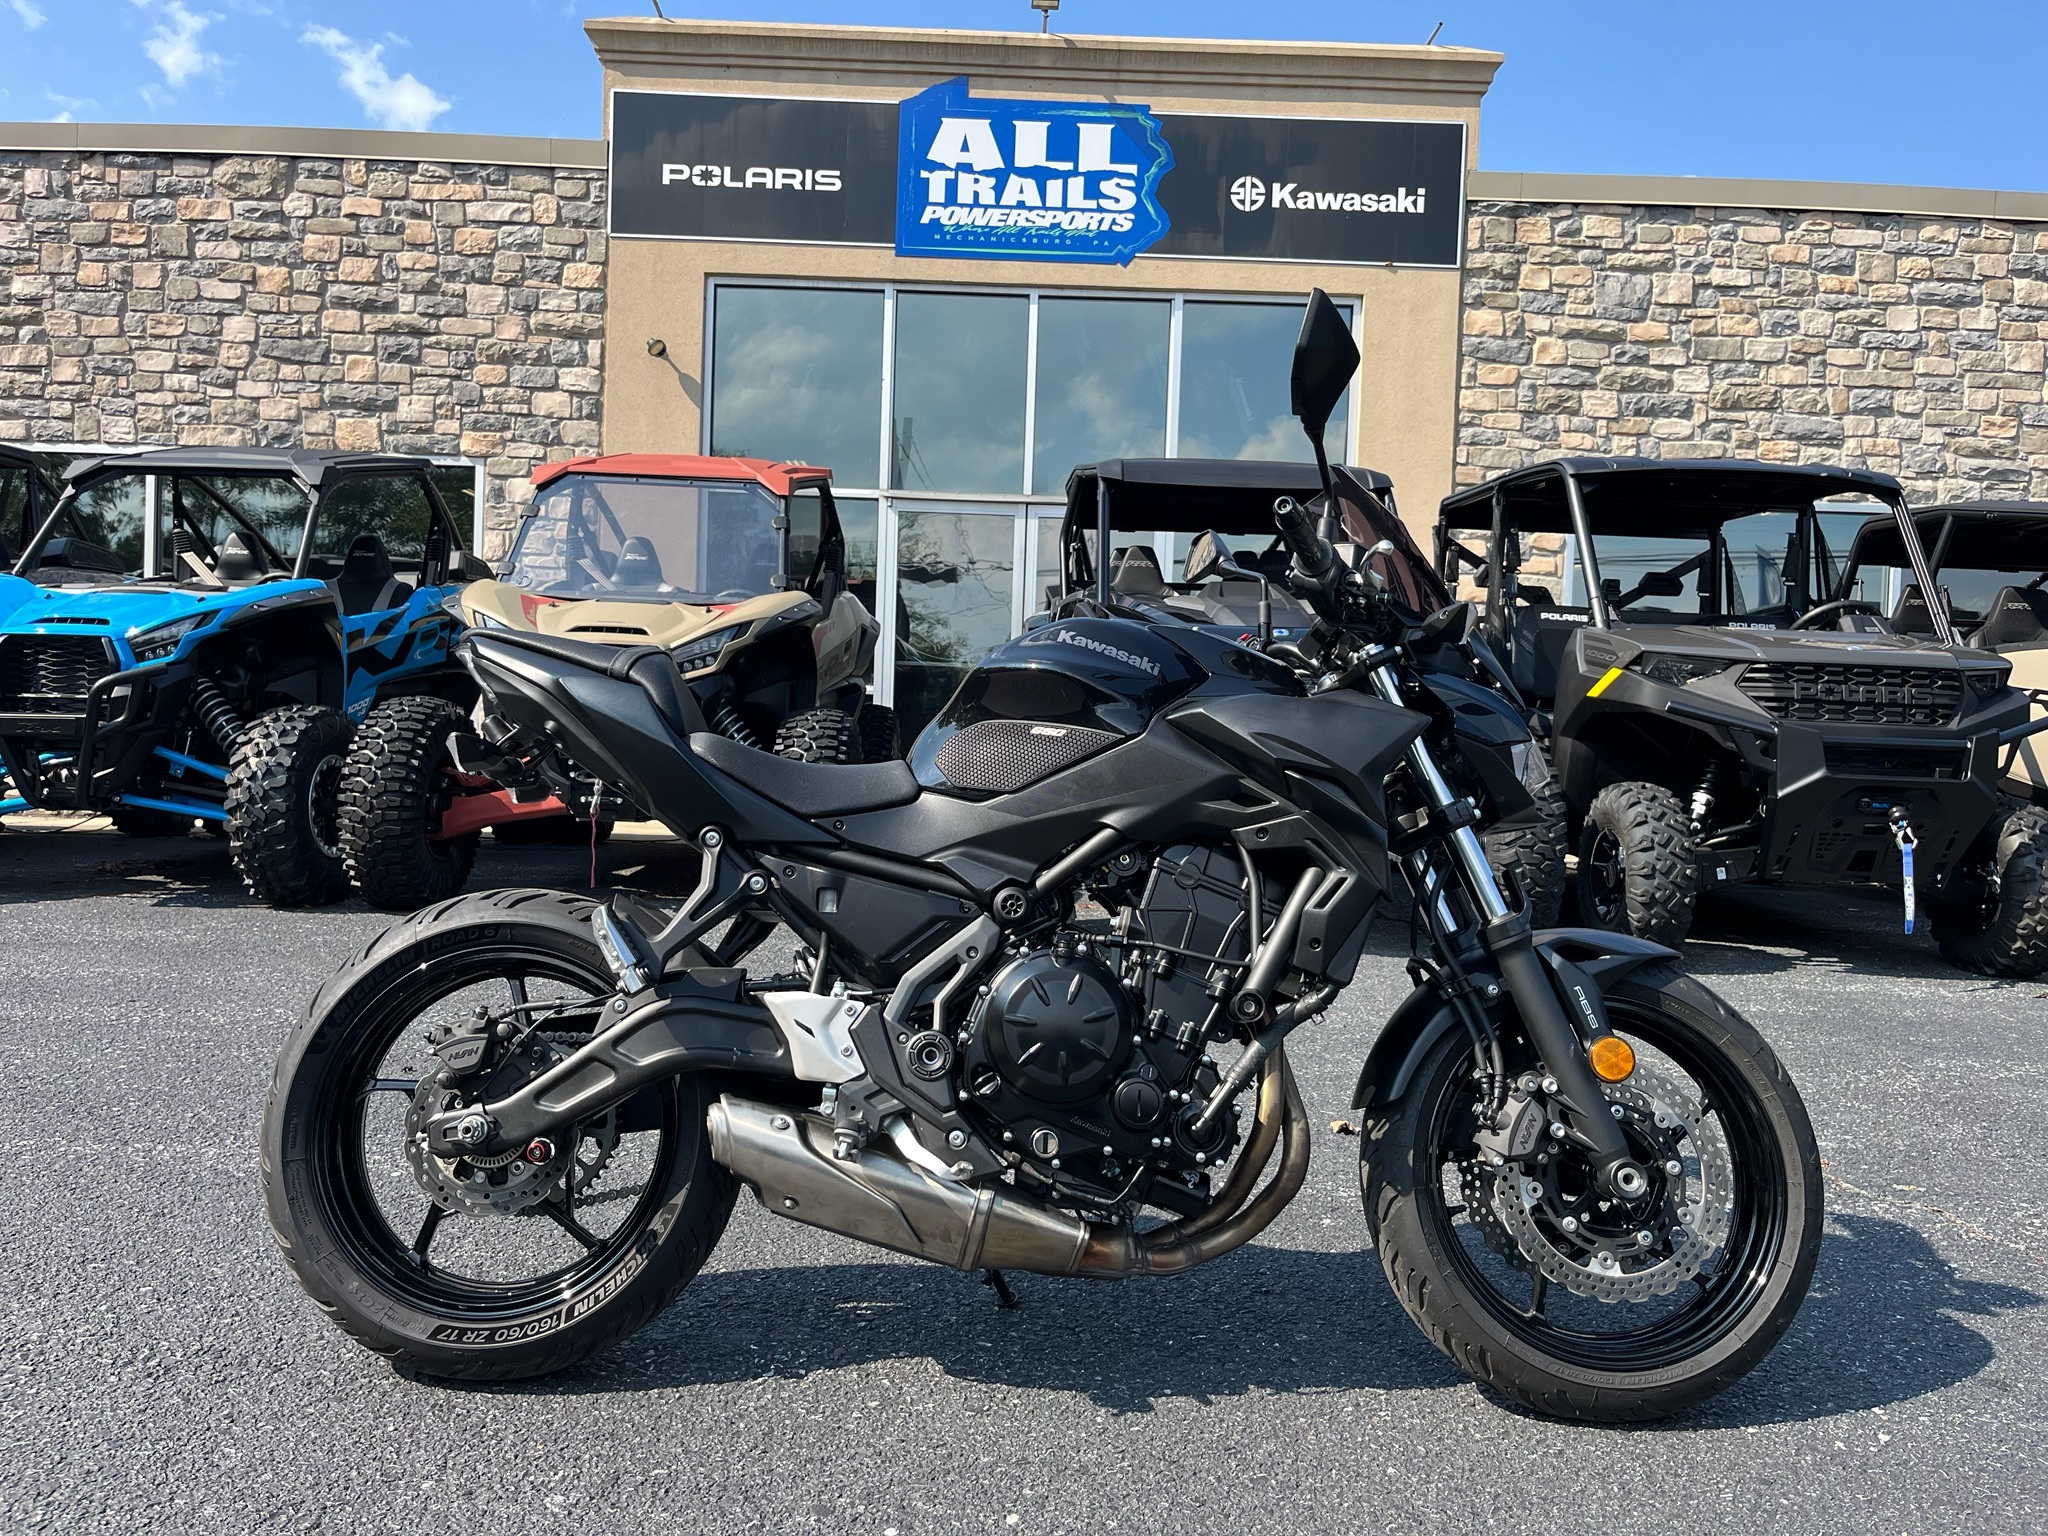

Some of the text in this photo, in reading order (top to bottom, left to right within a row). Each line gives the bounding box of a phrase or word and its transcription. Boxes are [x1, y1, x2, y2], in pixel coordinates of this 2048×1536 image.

[926, 117, 1138, 176] ALL
[662, 163, 842, 192] POLARIS
[920, 169, 1137, 211] TRAILS
[1271, 182, 1426, 214] Kawasaki
[919, 205, 1136, 233] POWERSPORTS
[1540, 612, 1589, 623] POLARIS
[1728, 621, 1777, 630] POLARIS
[1056, 629, 1161, 677] Kawasaki
[1585, 649, 1618, 662] 1000
[1793, 681, 1934, 705] POLARIS
[1904, 876, 1915, 921] POLARIS
[333, 926, 496, 1024] MICHELIN ROAD 6
[1573, 985, 1599, 1029] ABS
[1070, 1115, 1113, 1138] Kawasaki
[573, 1234, 656, 1317] MICHELIN
[436, 1327, 459, 1341] 17
[462, 1329, 491, 1343] ZR
[494, 1313, 560, 1342] 160/60
[1553, 1365, 1683, 1386] MICHELIN 120/70 ZR 17
